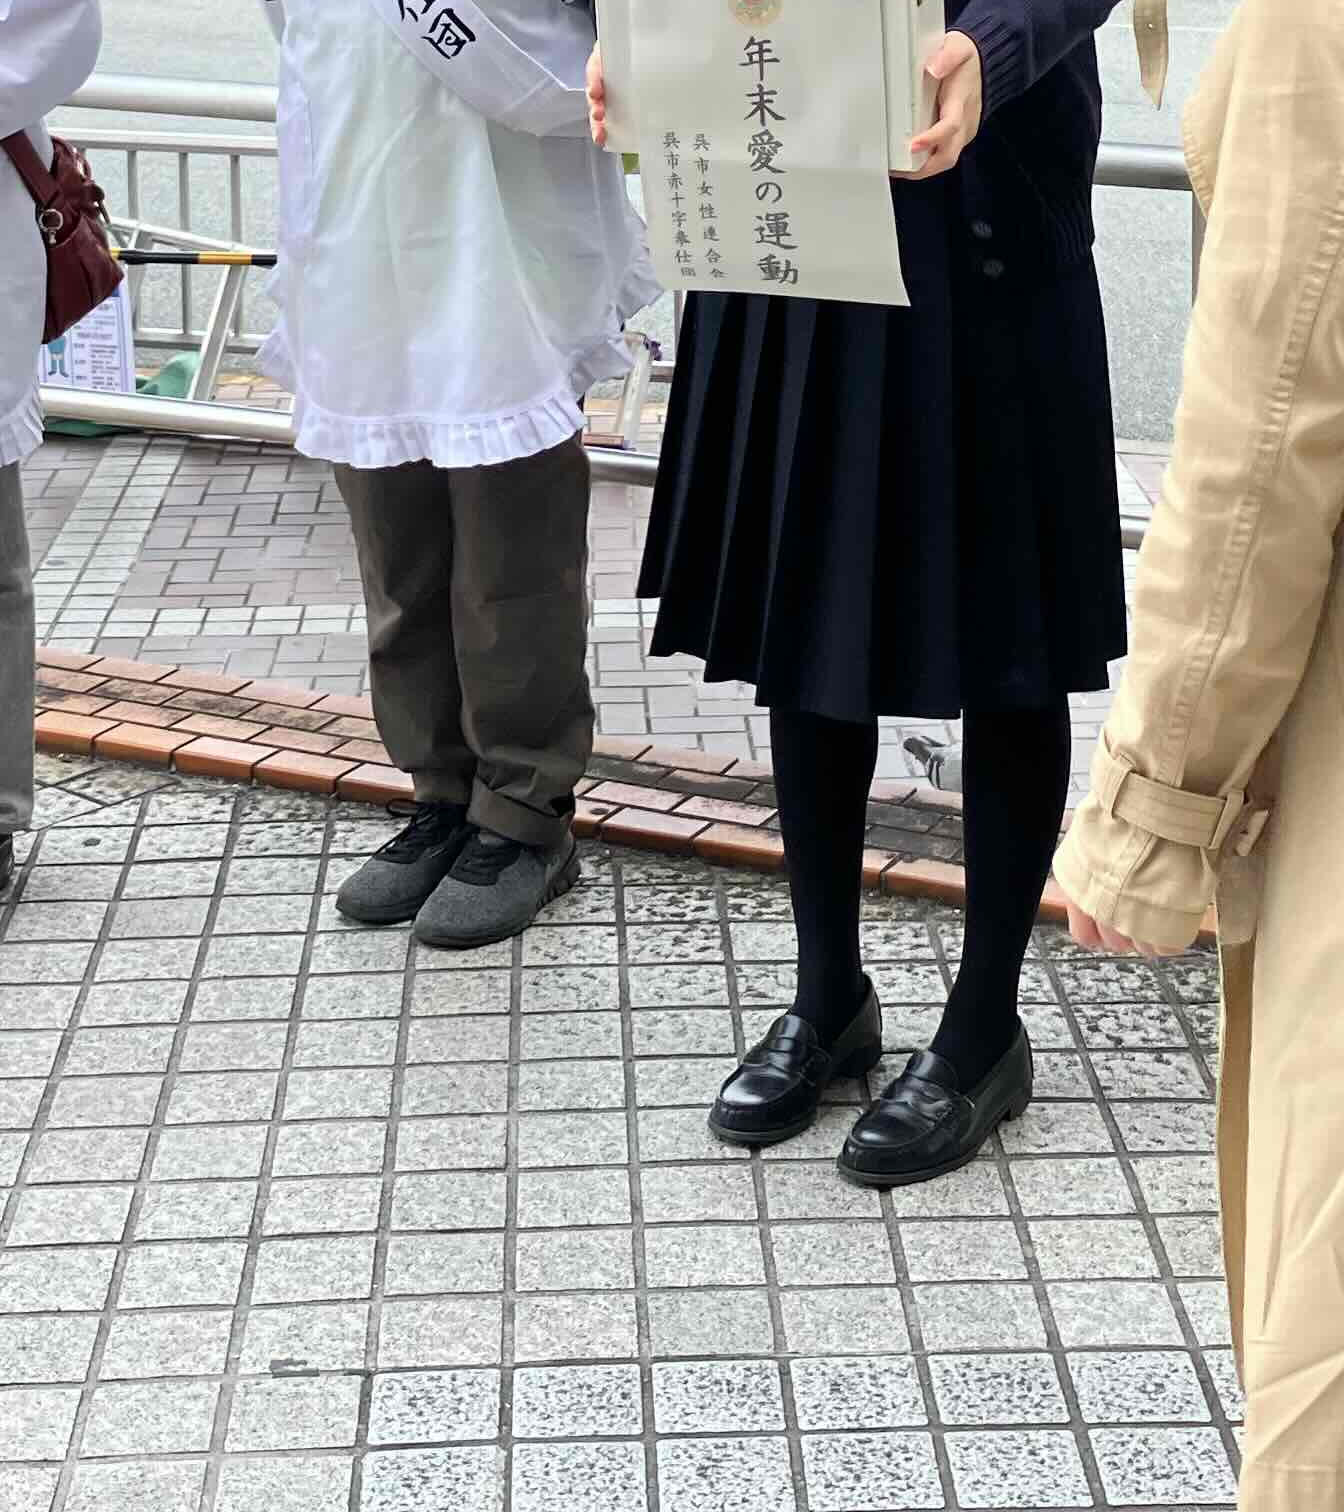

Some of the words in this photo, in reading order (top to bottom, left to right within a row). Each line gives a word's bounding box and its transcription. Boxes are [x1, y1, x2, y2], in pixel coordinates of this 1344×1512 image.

[738, 36, 799, 285] 年末愛の運動
